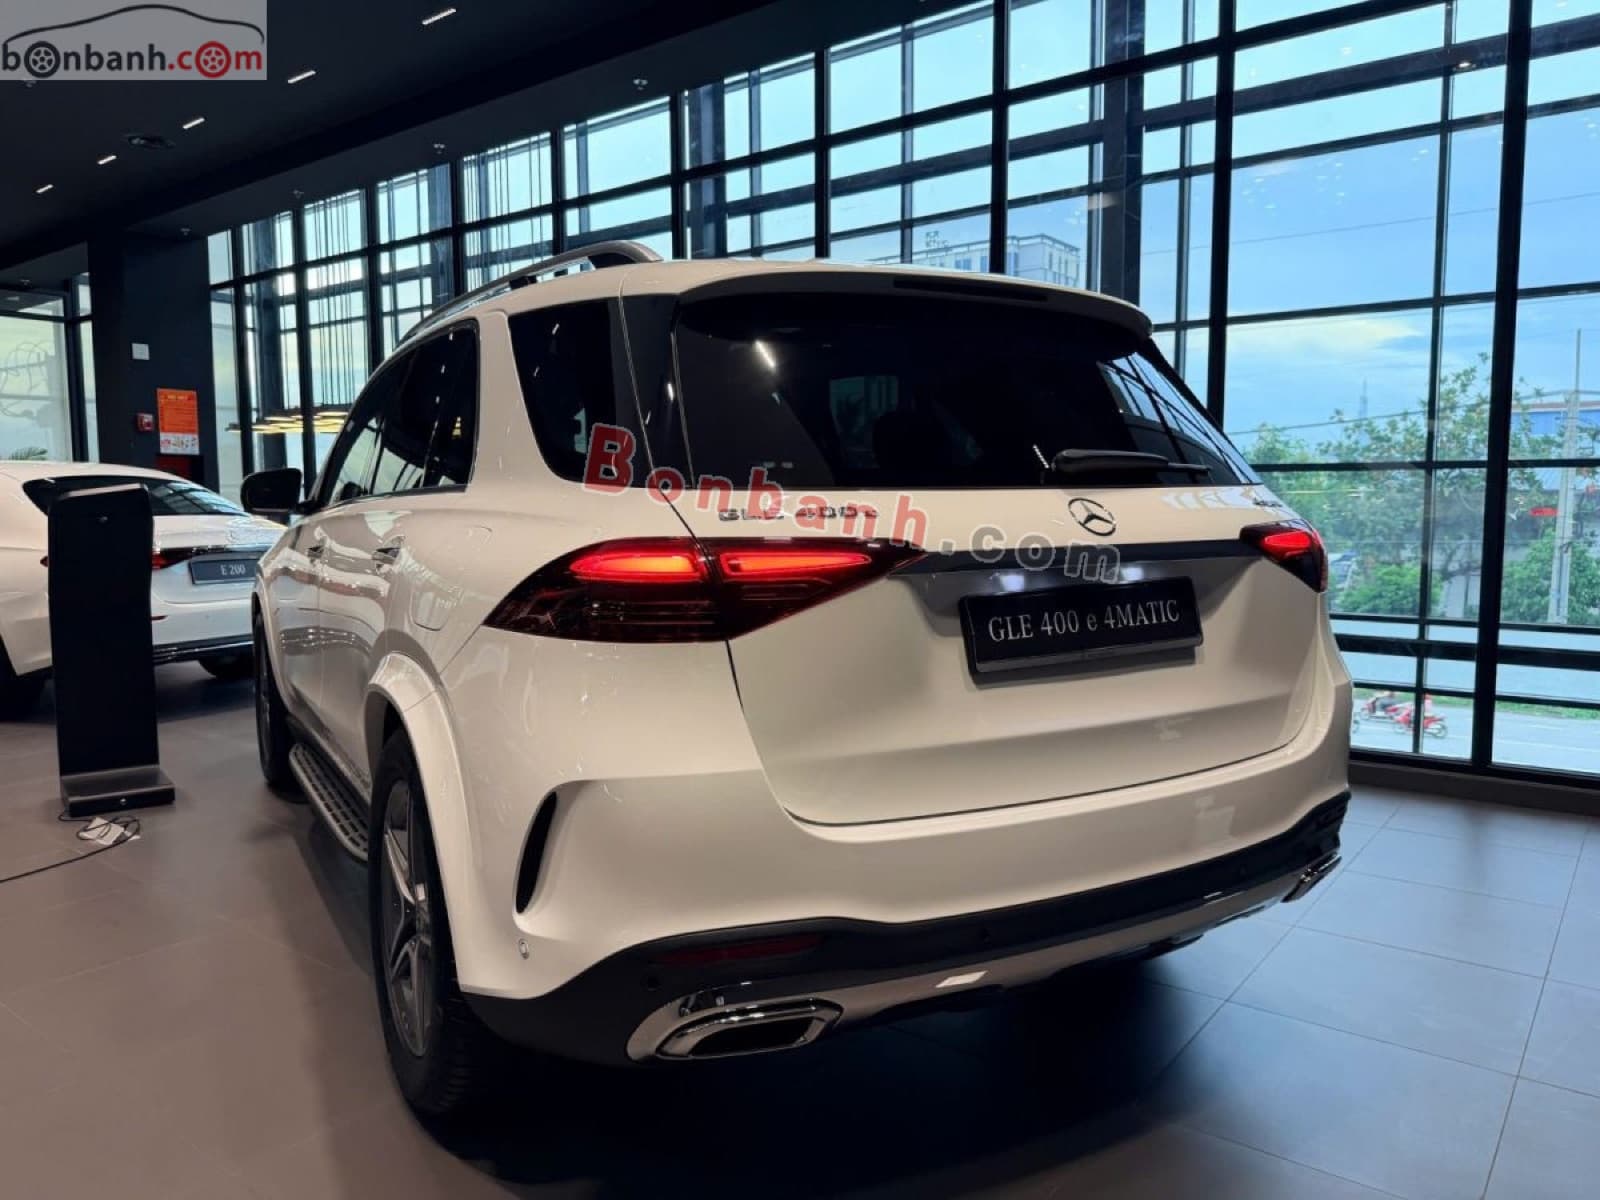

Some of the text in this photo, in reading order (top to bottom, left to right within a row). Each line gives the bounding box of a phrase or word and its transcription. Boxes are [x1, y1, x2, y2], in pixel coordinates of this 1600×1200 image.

[220, 564, 246, 576] E 200
[988, 599, 1180, 642] GLE 400 e 4MATIC
